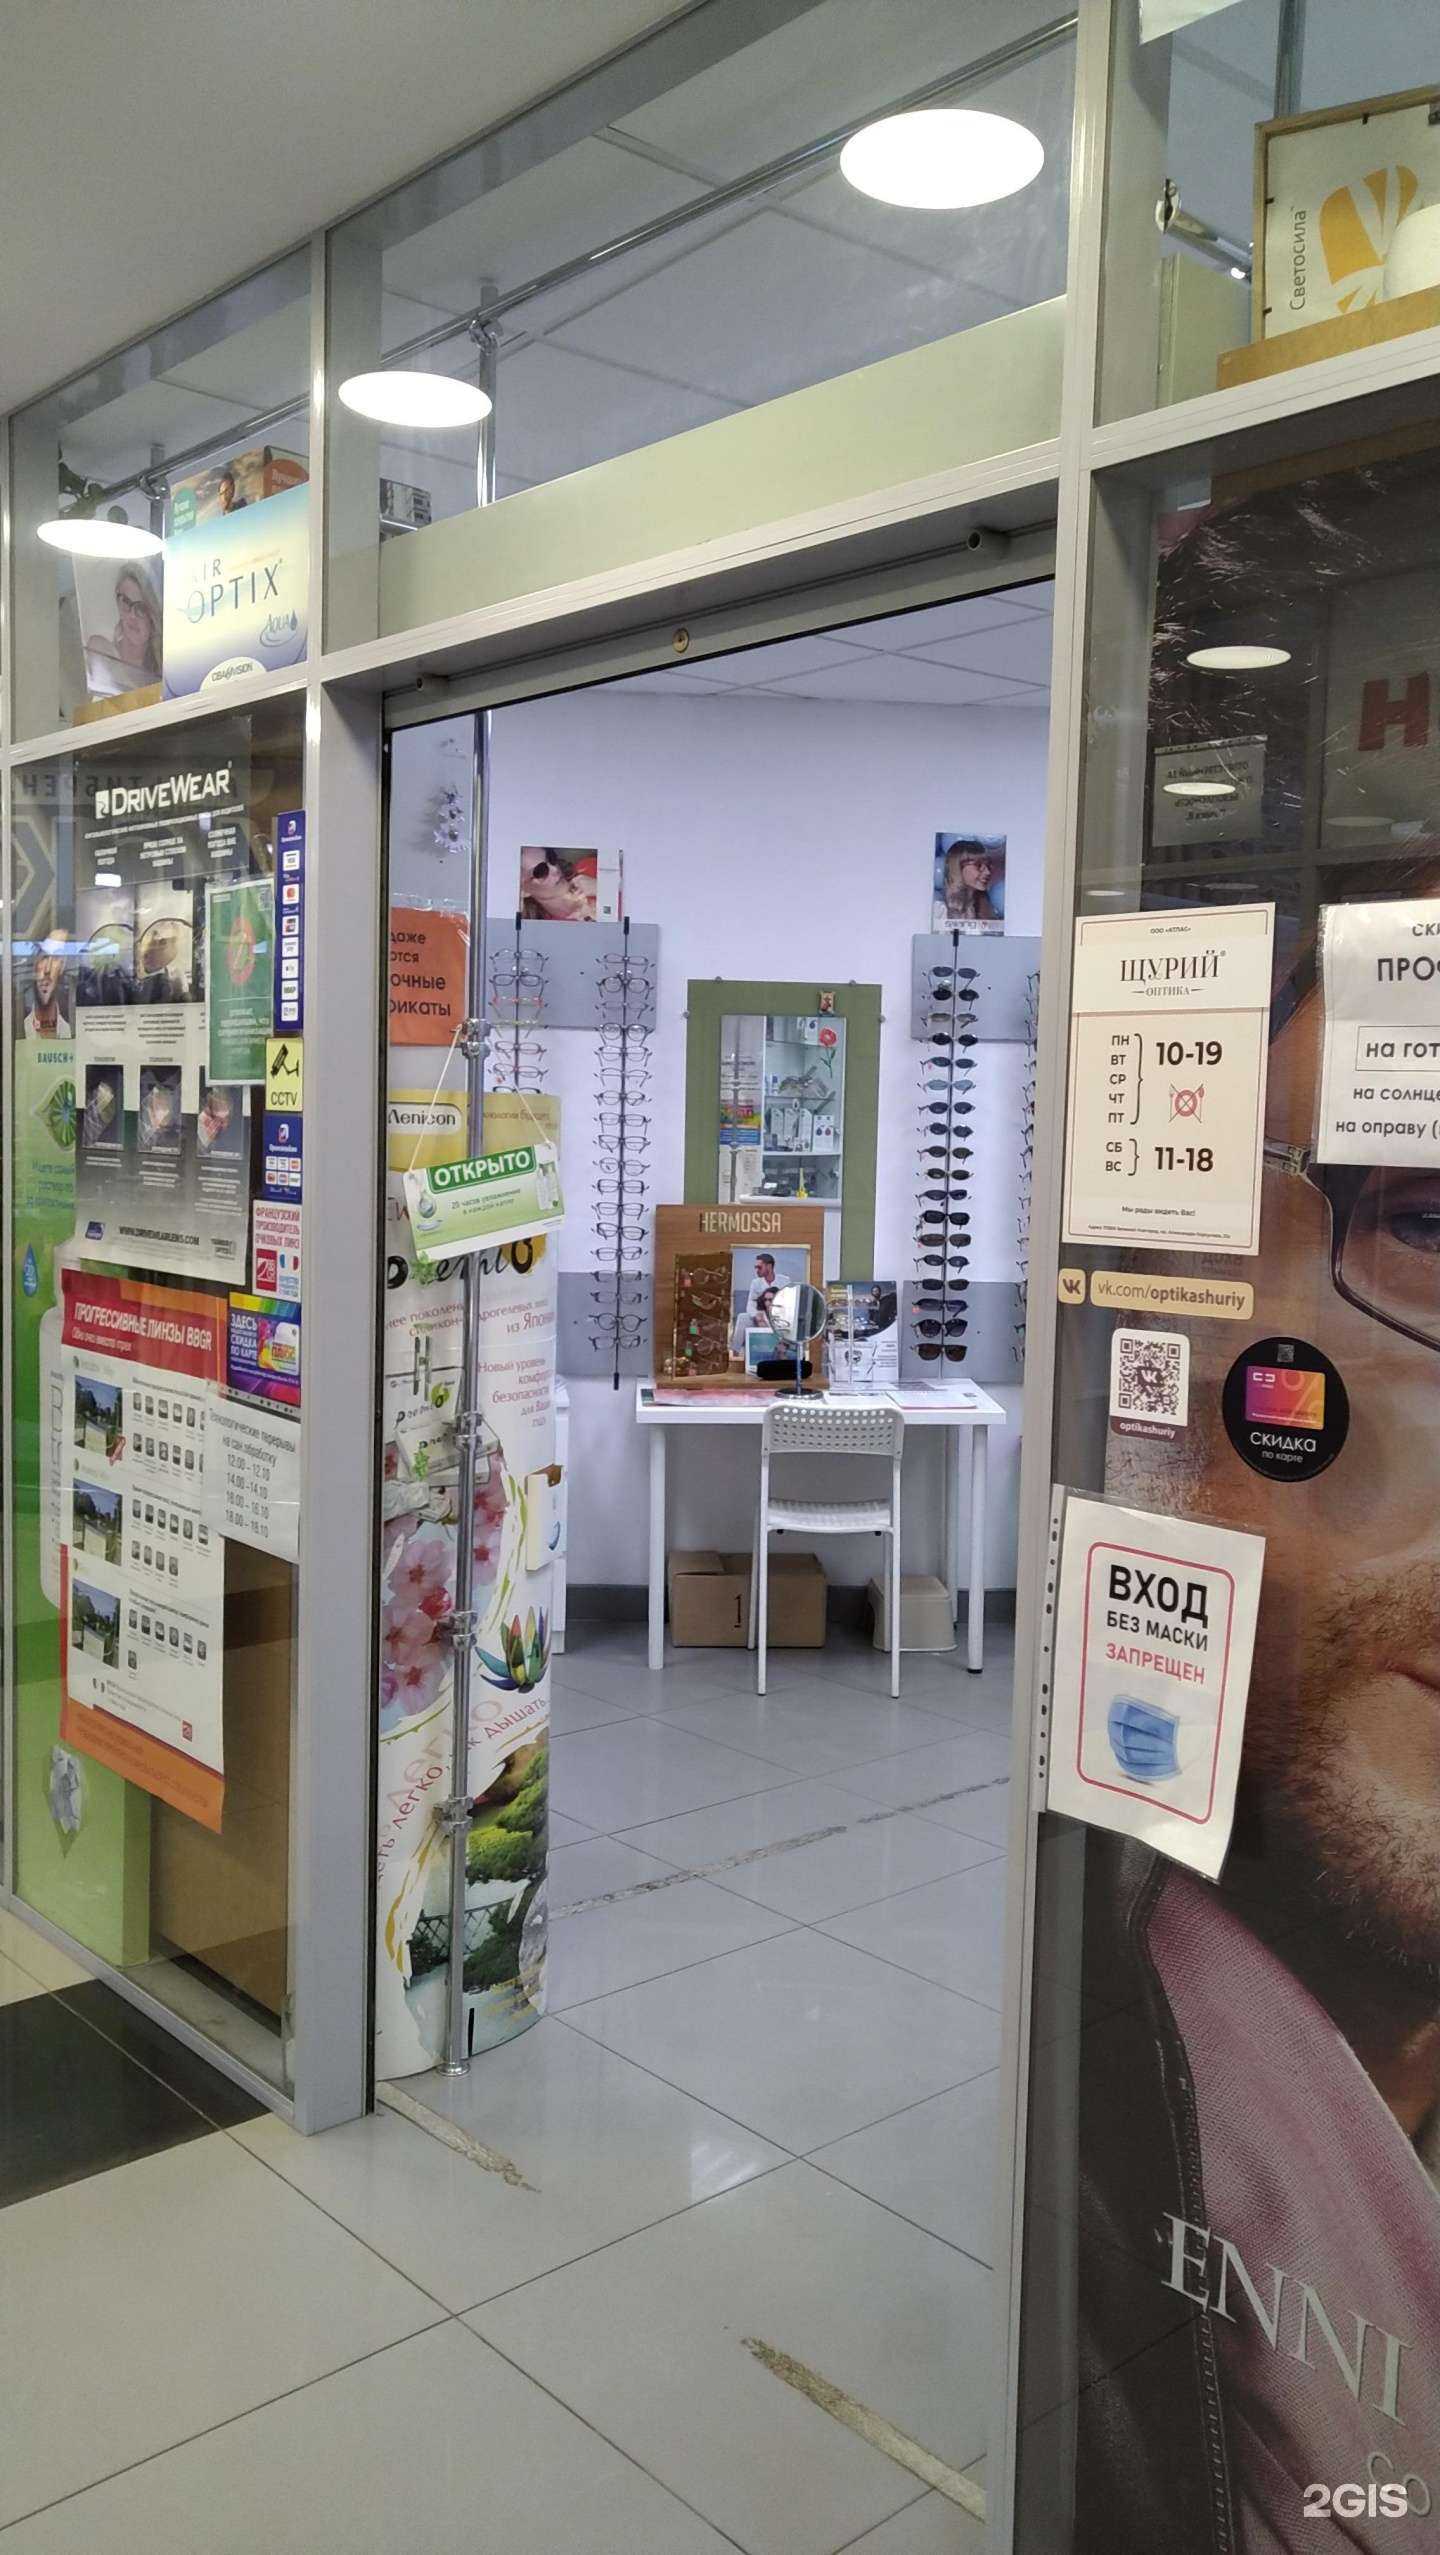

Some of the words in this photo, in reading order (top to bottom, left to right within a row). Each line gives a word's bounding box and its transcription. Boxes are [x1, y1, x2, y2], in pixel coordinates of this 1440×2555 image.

[1289, 210, 1307, 311] Светосила
[187, 563, 279, 624] OPTIX
[1120, 949, 1220, 985] ЩУРИЙ
[1378, 956, 1440, 981] ПРО
[1145, 985, 1190, 997] ОПТИКА
[1111, 1035, 1130, 1047] ПН
[1366, 1043, 1395, 1058] на
[1110, 1055, 1126, 1066] ВТ
[1155, 1041, 1223, 1066] 10-19
[1109, 1074, 1127, 1085] СР
[271, 1091, 298, 1106] CCTV
[1108, 1093, 1125, 1104] ЧТ
[1353, 1088, 1375, 1100] на
[1107, 1112, 1125, 1124] ПТ
[1336, 1121, 1356, 1133] на
[1362, 1122, 1427, 1139] оправу
[1105, 1142, 1123, 1153] СБ
[1105, 1161, 1122, 1173] ВС
[1155, 1146, 1214, 1172] 11-18
[434, 1151, 531, 1187] ОТКРЫТО
[700, 1211, 782, 1233] HERMOSSA
[1098, 1280, 1246, 1311] vk.com/optikashuriy
[410, 1301, 465, 1322] поколен
[75, 1301, 147, 1336] ПРОГРЕССИВНЫЕ
[147, 1317, 186, 1345] ЛИНЗЫ
[1120, 1422, 1176, 1439] optikashuriy
[1262, 1451, 1274, 1460] по
[1109, 1564, 1208, 1629] ВХОД
[1106, 1610, 1141, 1634] БЕЗ
[1146, 1620, 1208, 1653] МАСКИ
[1105, 1642, 1206, 1686] ЗАПРЕЩЕН
